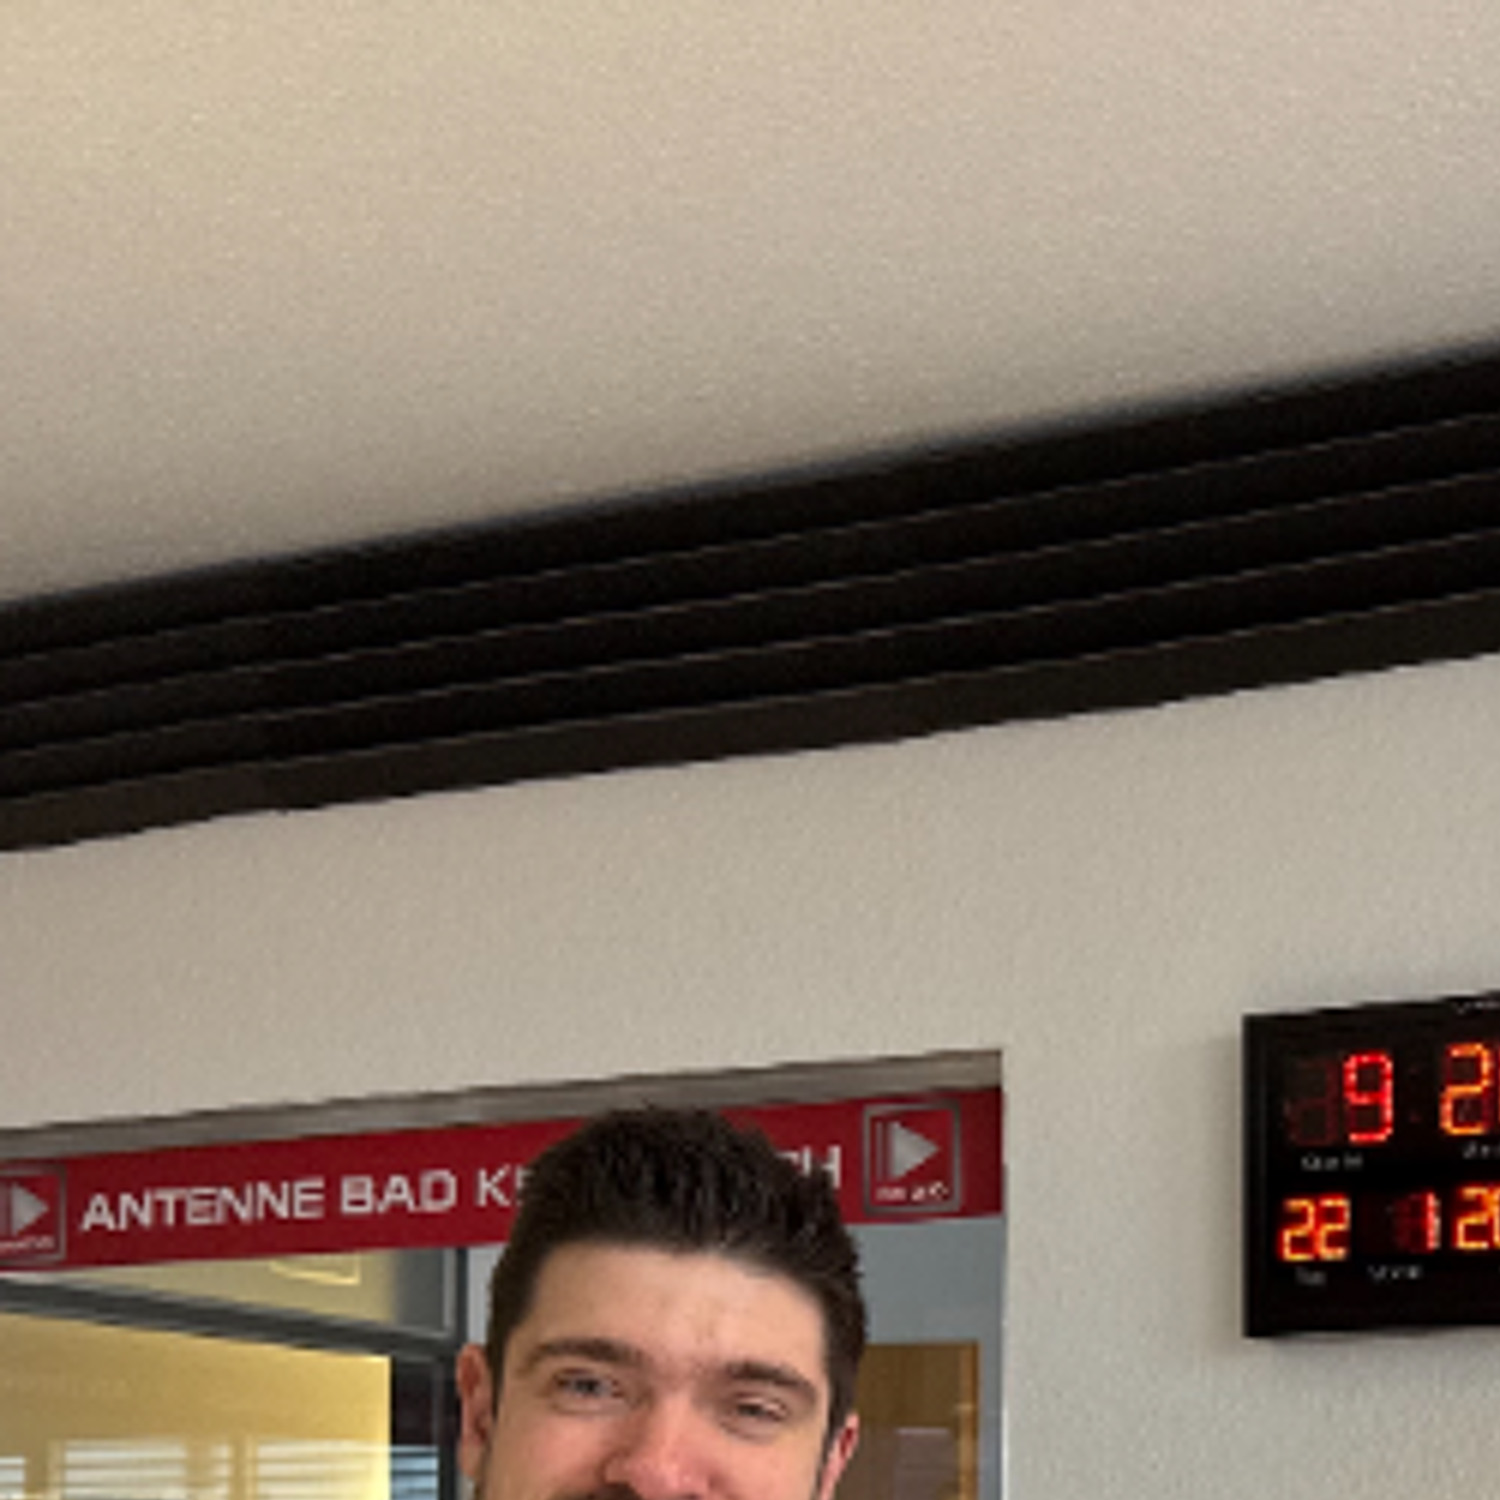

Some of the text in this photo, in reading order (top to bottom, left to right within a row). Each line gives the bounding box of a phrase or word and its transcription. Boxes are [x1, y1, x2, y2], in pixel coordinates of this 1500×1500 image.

[1342, 1050, 1393, 1143] 9
[80, 1175, 325, 1232] ANTENNE
[341, 1168, 458, 1214] BAD
[1282, 1195, 1351, 1262] 22
